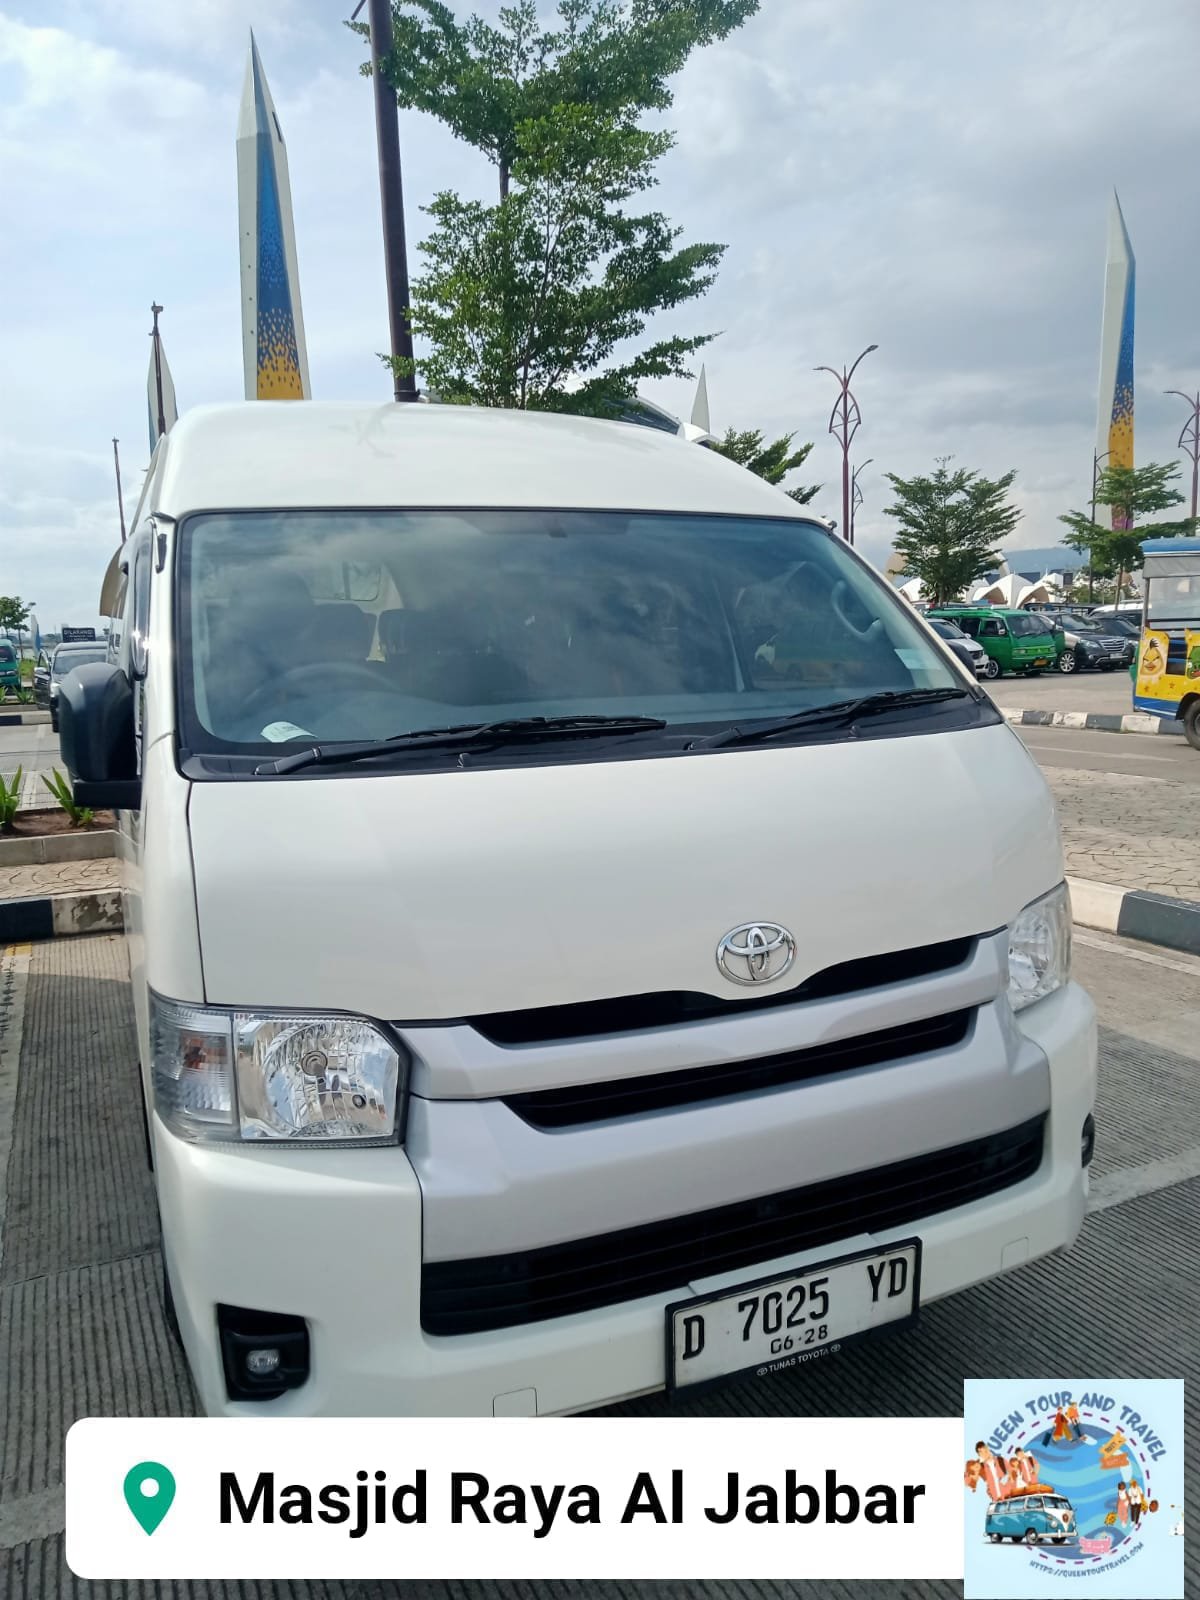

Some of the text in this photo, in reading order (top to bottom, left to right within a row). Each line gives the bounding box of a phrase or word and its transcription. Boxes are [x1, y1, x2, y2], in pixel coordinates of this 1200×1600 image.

[682, 1256, 908, 1360] D 7025 YD
[768, 1347, 830, 1373] TUNAS TOYOTA
